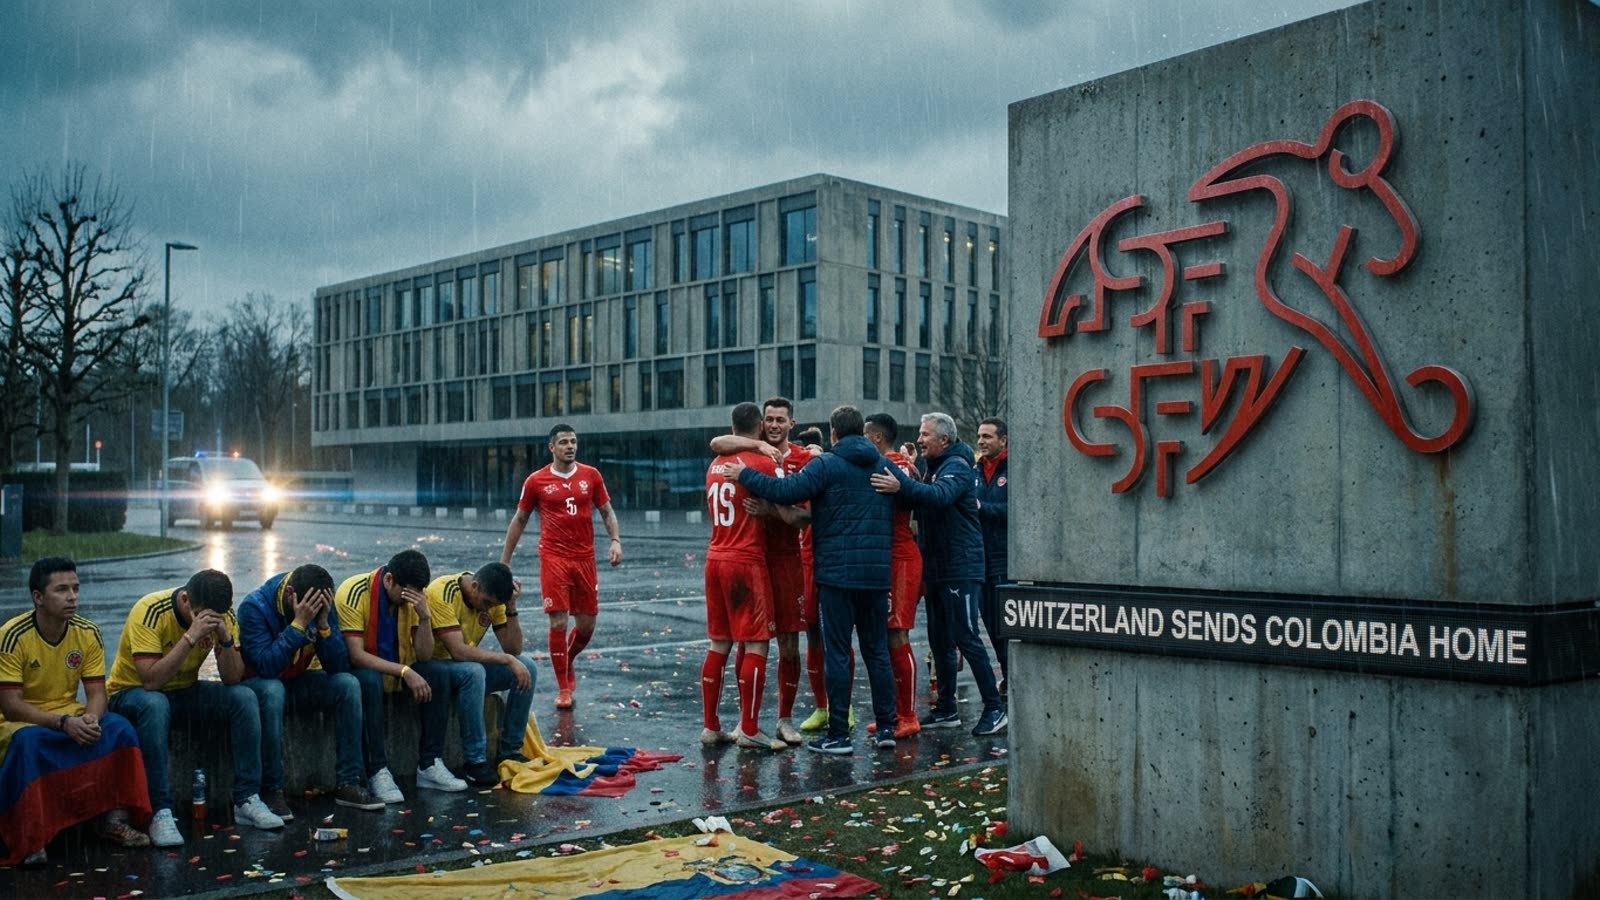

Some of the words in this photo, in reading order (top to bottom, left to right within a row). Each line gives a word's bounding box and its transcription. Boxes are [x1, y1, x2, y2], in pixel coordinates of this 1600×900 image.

[565, 497, 577, 516] 5
[1004, 599, 1165, 637] SWITZERLAND
[1171, 609, 1258, 645] SENDS
[1265, 615, 1421, 657] COLOMBIA
[1429, 625, 1528, 665] HOME
